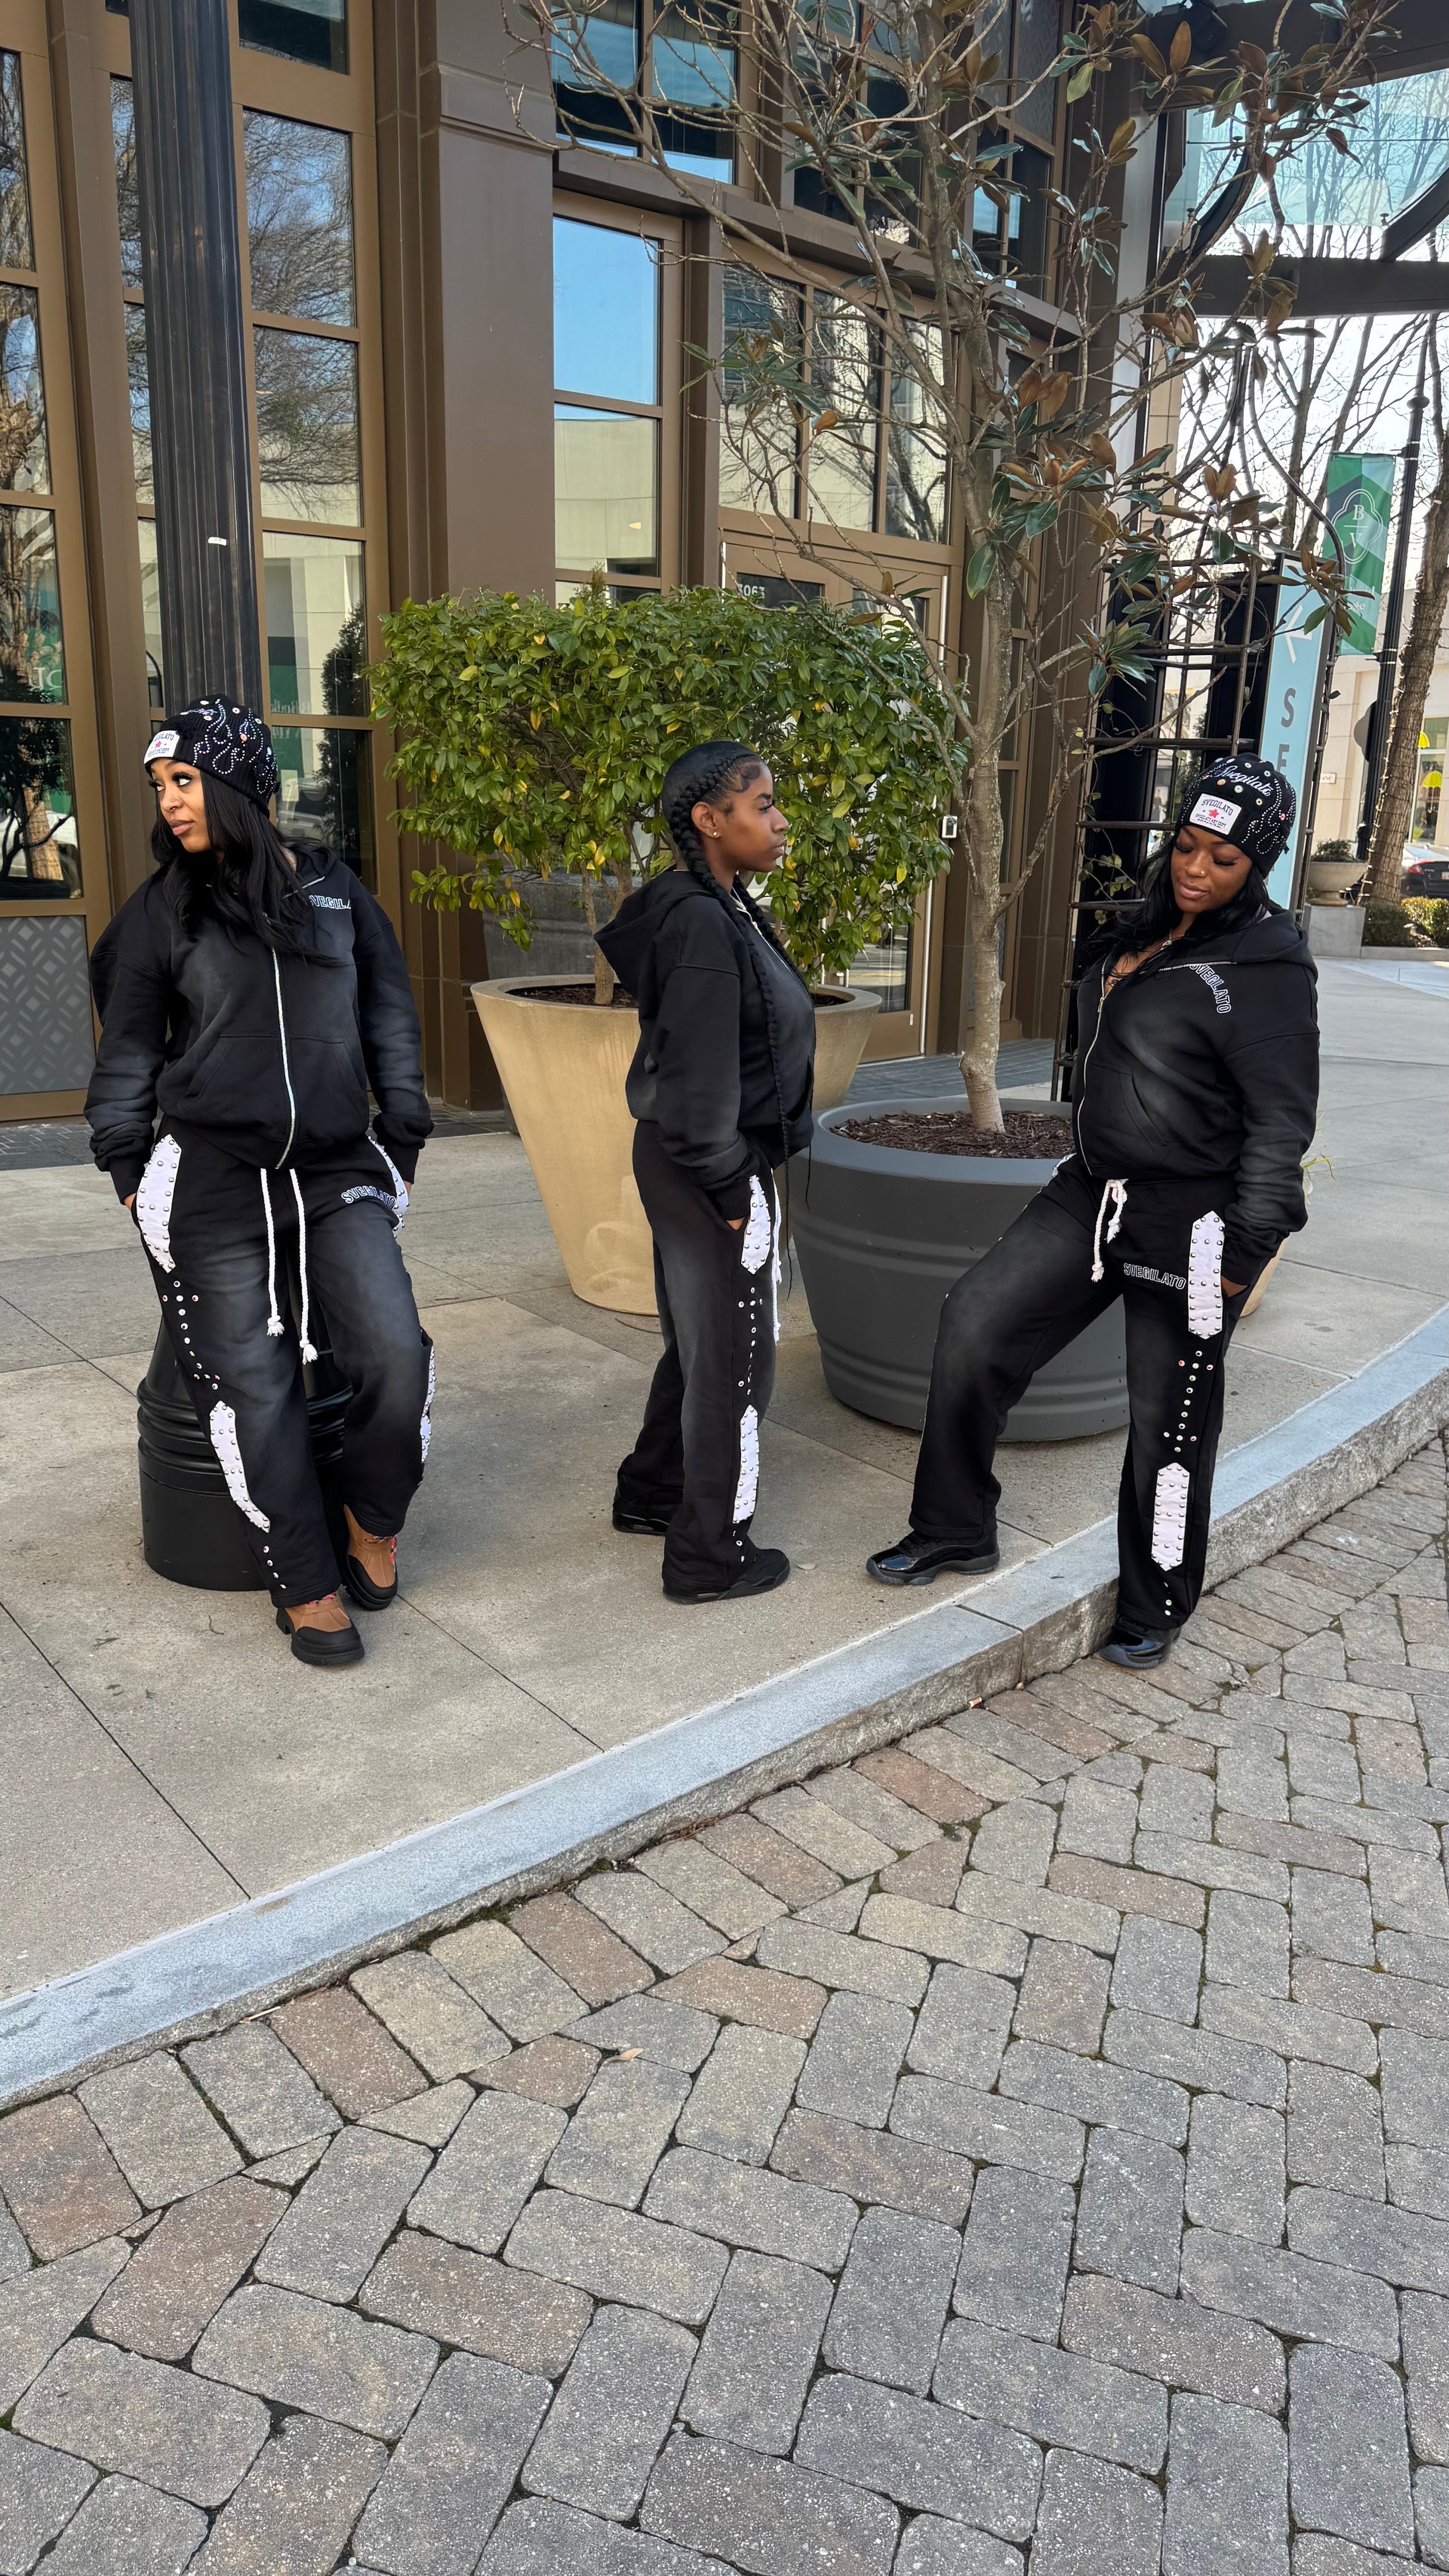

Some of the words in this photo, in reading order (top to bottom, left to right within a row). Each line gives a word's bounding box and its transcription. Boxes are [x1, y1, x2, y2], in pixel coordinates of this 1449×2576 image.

[1352, 504, 1364, 520] B
[1349, 532, 1362, 548] V
[1201, 799, 1234, 816] SVEGILATO
[1123, 1263, 1186, 1290] SVEGILATO
